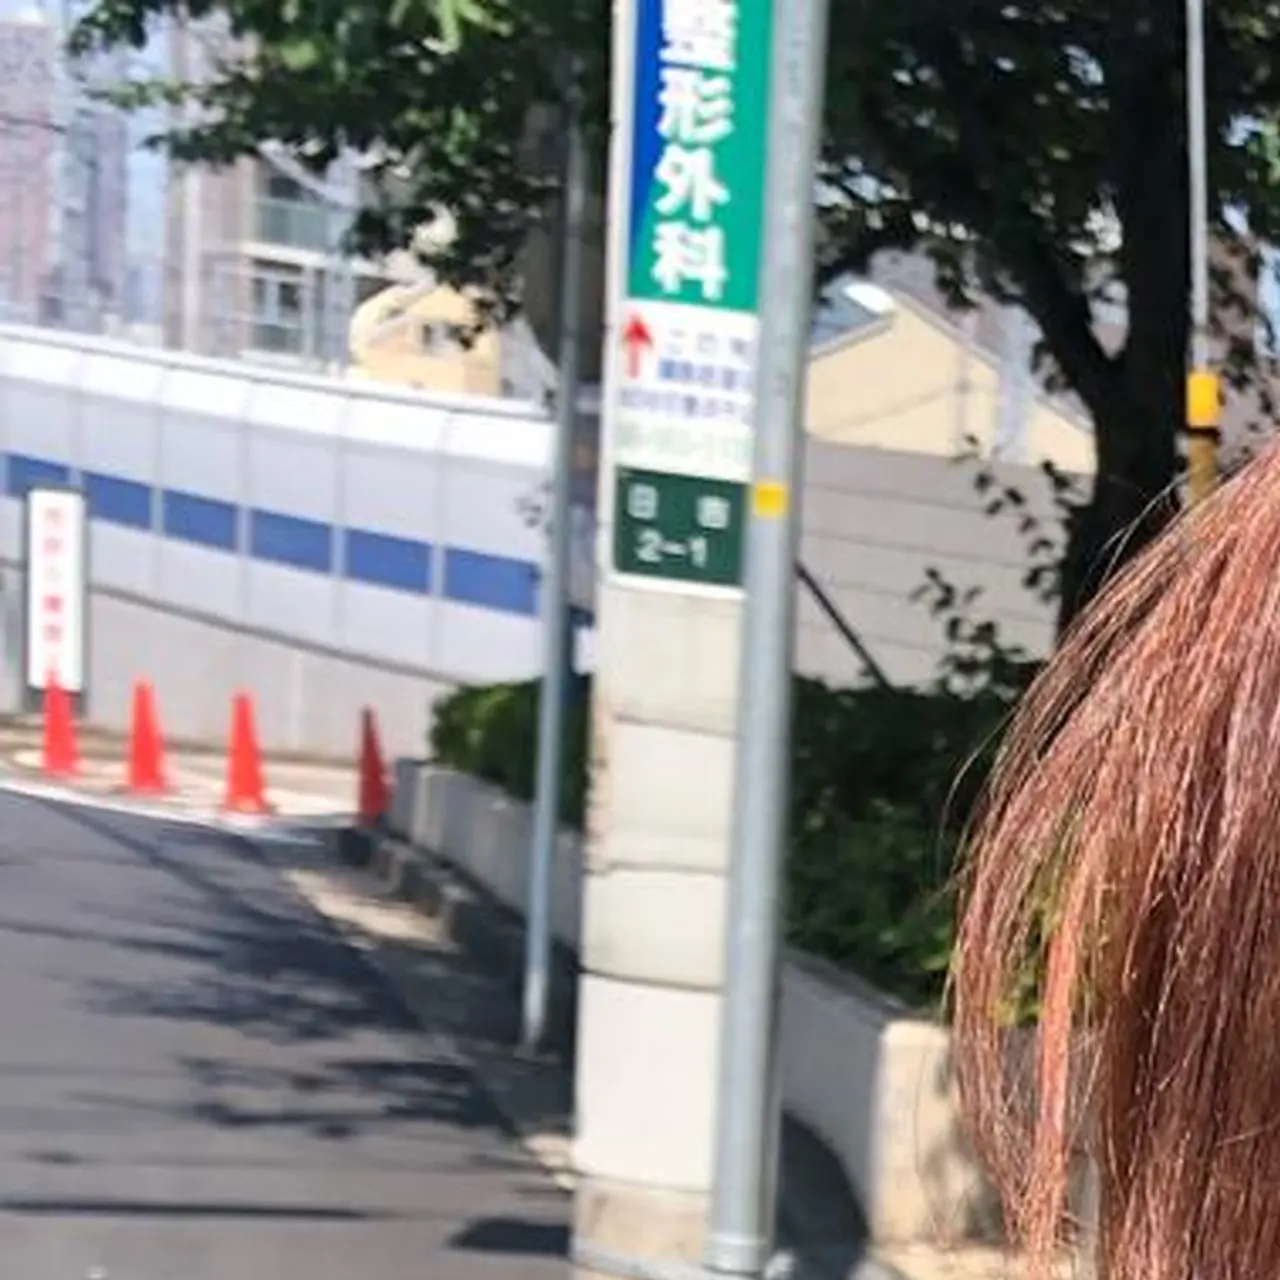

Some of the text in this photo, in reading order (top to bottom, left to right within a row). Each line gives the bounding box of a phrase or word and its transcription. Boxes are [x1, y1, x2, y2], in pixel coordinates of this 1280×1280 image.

[652, 0, 737, 299] 整形外科
[634, 528, 708, 568] 2-1
